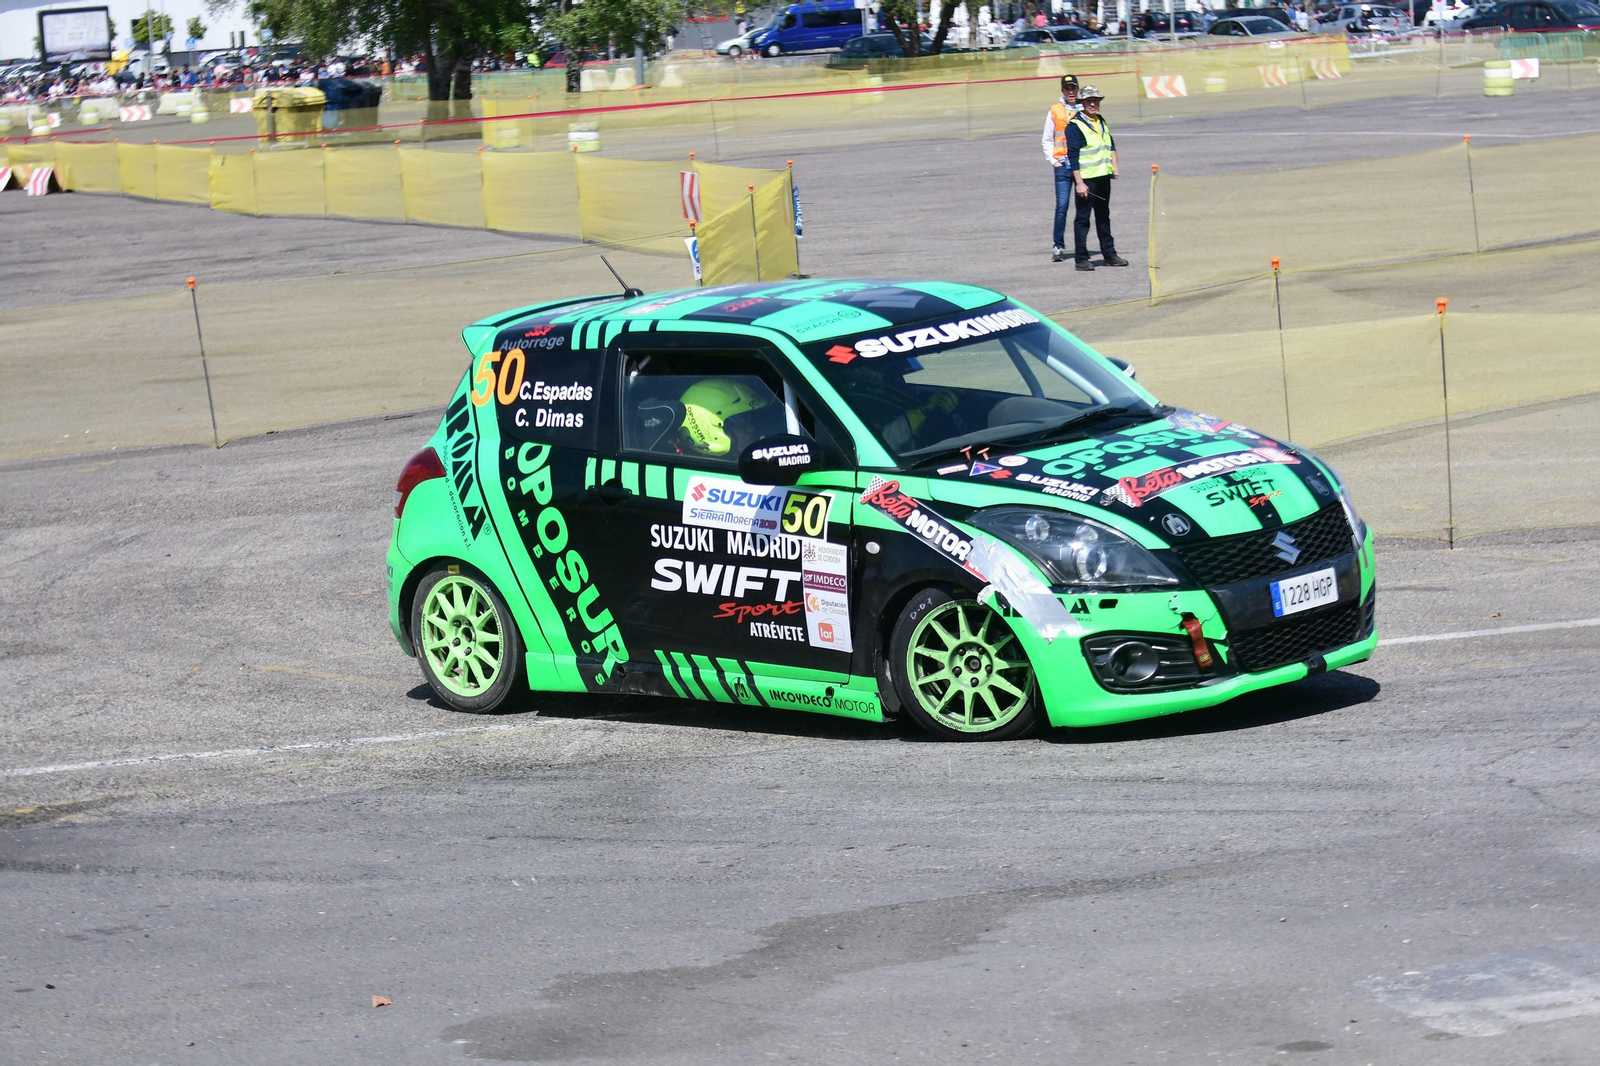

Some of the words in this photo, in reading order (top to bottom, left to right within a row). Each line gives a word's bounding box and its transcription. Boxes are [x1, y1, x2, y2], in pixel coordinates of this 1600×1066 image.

[499, 335, 565, 351] Autorrege
[854, 317, 985, 358] SUZUKI
[975, 308, 1040, 334] MADRID
[471, 348, 526, 407] 50
[519, 381, 593, 404] C.Espadas
[515, 408, 530, 427] C.
[535, 408, 584, 428] Dimas
[686, 406, 706, 441] OPOSUR
[752, 443, 809, 460] SUZUKI
[778, 454, 811, 467] MADRID
[1015, 473, 1100, 496] SUZUKI
[1119, 466, 1183, 508] Beta
[1176, 452, 1267, 479] MOTOR
[1189, 476, 1228, 493] SUZUKI
[1229, 467, 1267, 482] MADRID
[707, 488, 782, 511] SUZUKI
[1042, 486, 1092, 502] MADRID
[1205, 478, 1275, 508] SWIFT
[449, 490, 466, 537] decoración
[782, 493, 827, 537] 50
[861, 480, 918, 519] Beta
[905, 509, 973, 561] MOTOR
[650, 524, 714, 552] SUZUKI
[727, 531, 801, 560] MADRID
[517, 441, 630, 678] OPOSUR
[651, 558, 801, 602] SWIFT
[813, 575, 846, 587] IMDECO
[1282, 582, 1311, 607] 1228
[1313, 576, 1333, 600] HGP
[821, 598, 847, 608] Diputación
[822, 605, 828, 613] de
[750, 621, 805, 642] ATRÉVETE
[820, 627, 832, 639] lar
[769, 689, 832, 708] INCOYDECO
[835, 698, 876, 714] MOTOR
